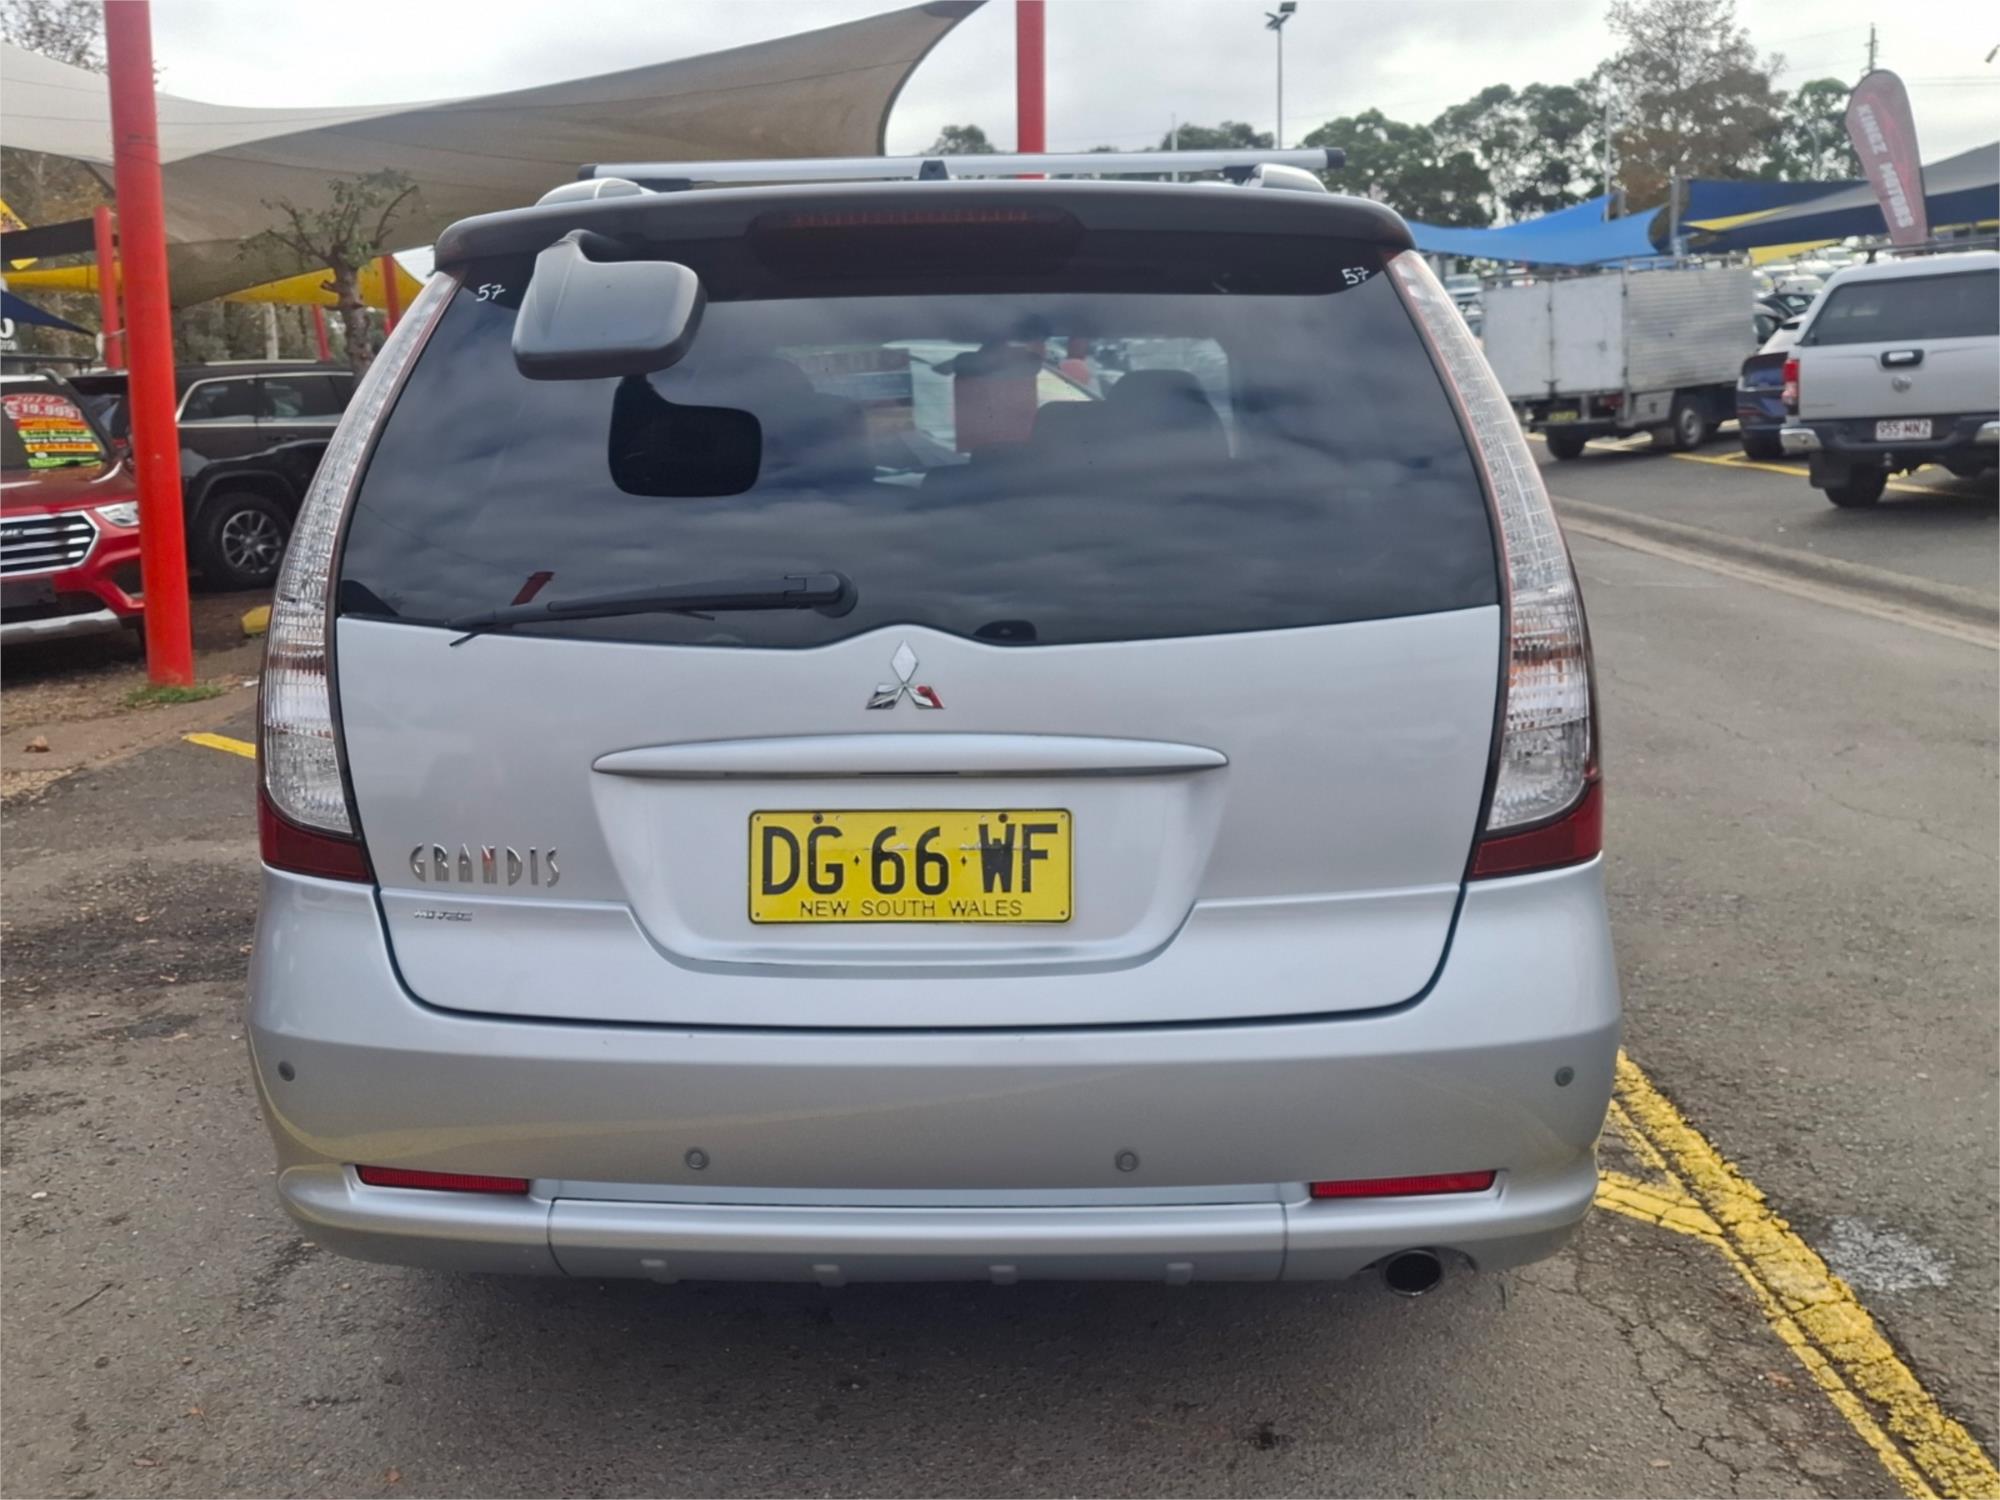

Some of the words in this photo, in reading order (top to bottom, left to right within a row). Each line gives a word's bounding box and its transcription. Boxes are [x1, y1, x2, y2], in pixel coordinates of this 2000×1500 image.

[1879, 161, 1914, 228] MOTORS
[475, 282, 506, 302] 57
[1341, 266, 1370, 285] 57
[409, 842, 560, 888] GRANDIS
[761, 826, 844, 895] DG
[871, 826, 950, 895] 66
[978, 824, 1058, 893] WF
[800, 900, 850, 917] NEW
[861, 899, 936, 917] SOUTH
[950, 899, 1022, 917] WALES
